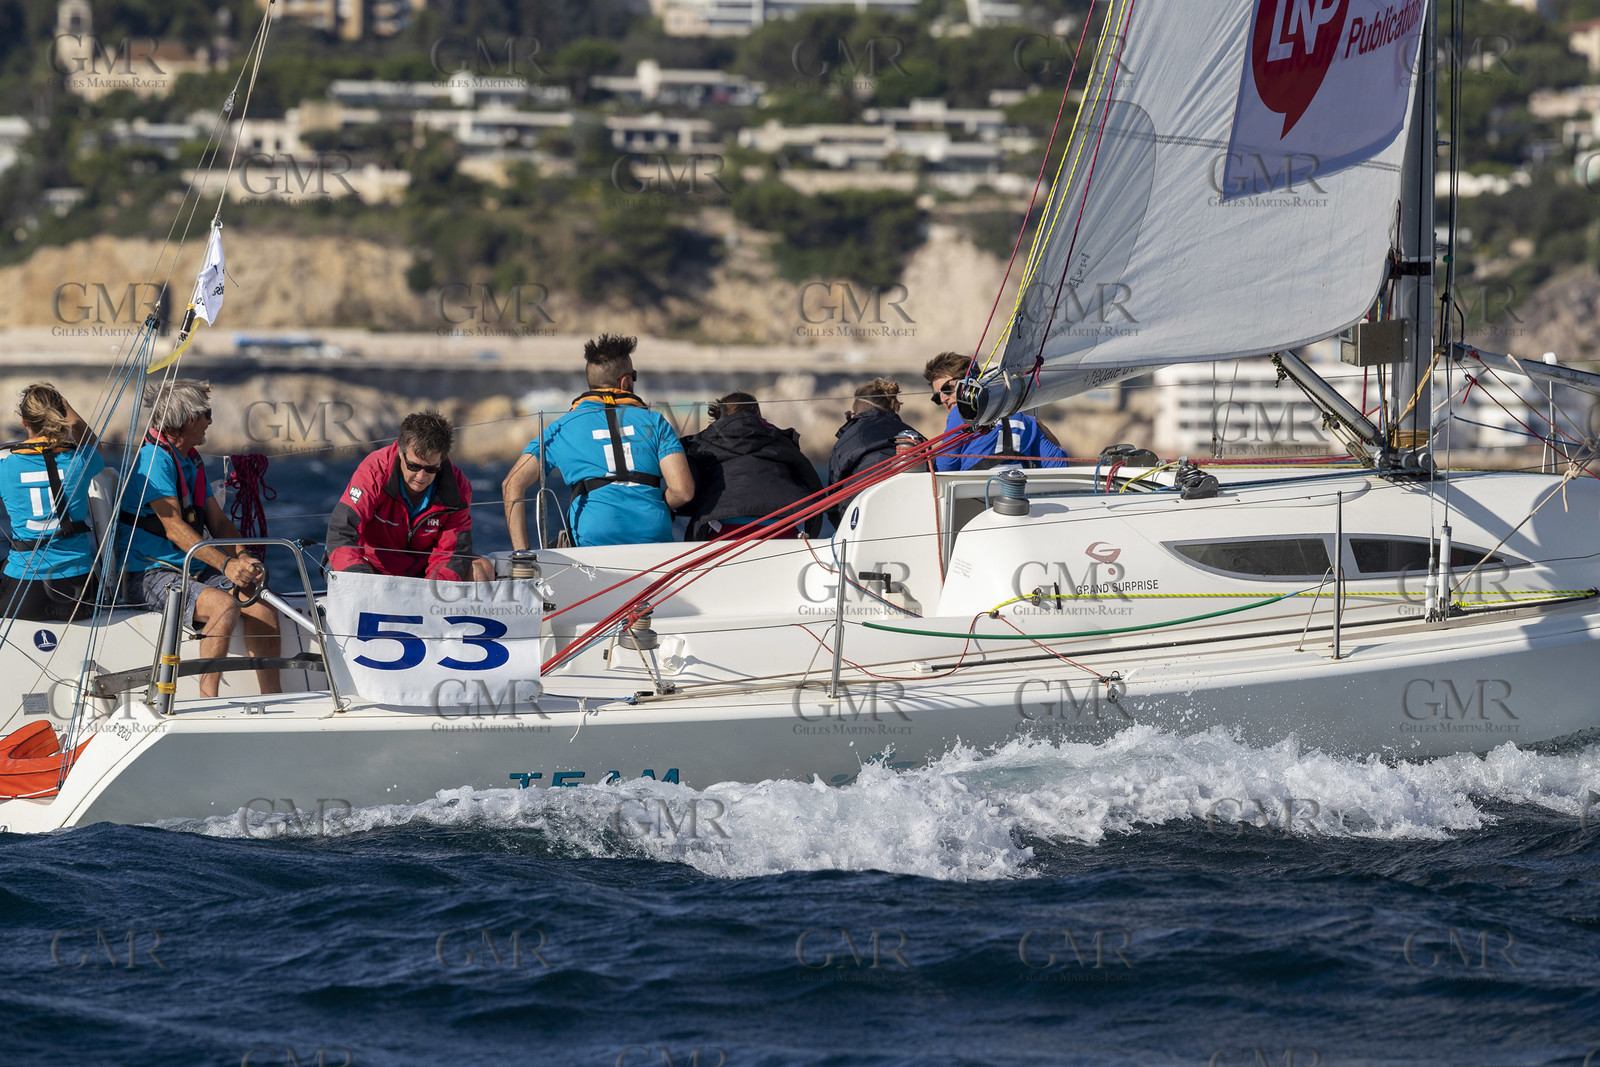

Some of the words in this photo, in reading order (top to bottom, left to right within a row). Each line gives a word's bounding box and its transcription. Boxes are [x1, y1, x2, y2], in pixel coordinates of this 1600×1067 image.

[1076, 583, 1109, 595] GRAND
[1112, 579, 1159, 593] SURPRISE
[353, 612, 510, 671] 53
